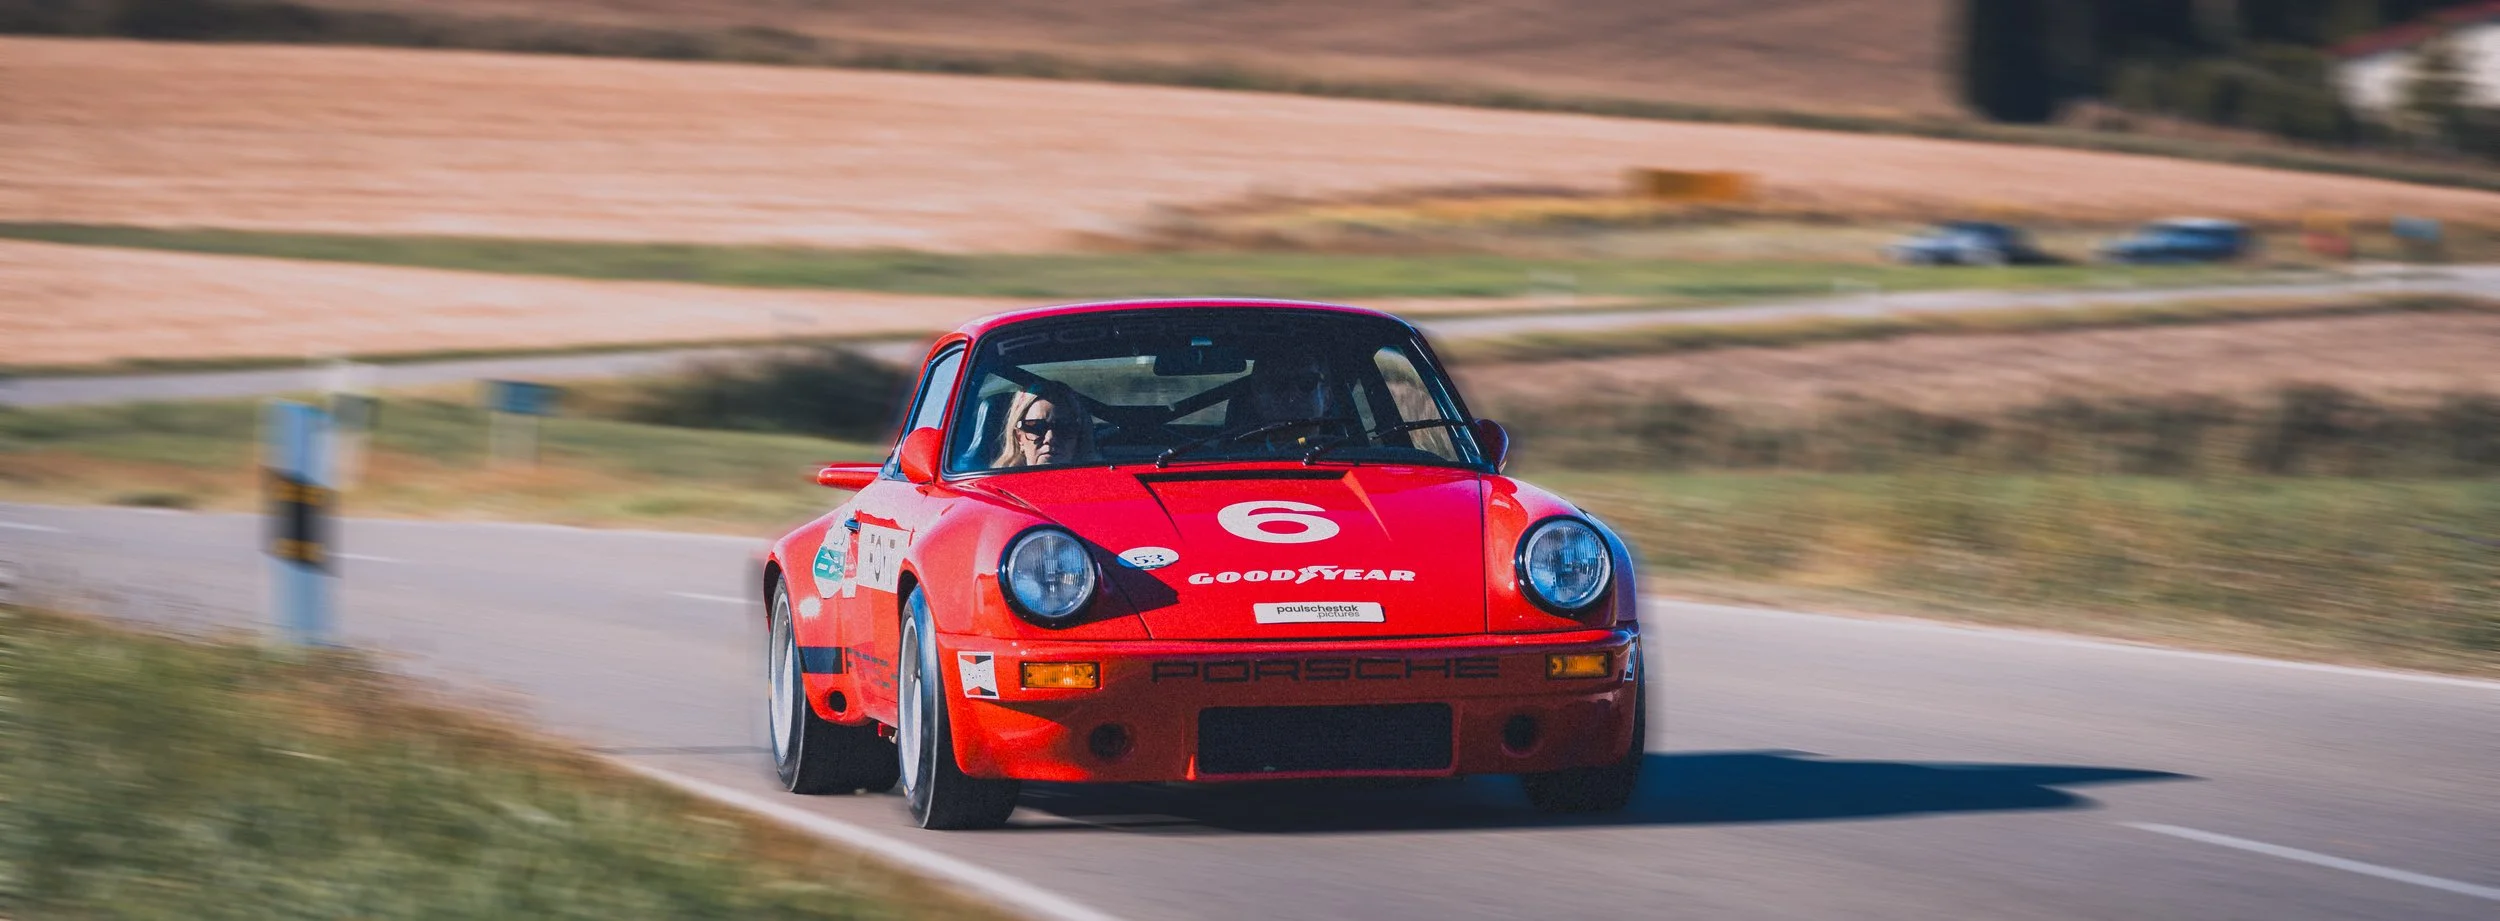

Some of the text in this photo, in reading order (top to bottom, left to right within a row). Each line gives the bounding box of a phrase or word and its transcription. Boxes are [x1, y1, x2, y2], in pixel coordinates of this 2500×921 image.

[1217, 500, 1340, 543] 6
[1188, 566, 1416, 585] GOODYEAR
[1276, 604, 1360, 614] paulschestak
[1152, 656, 1500, 683] PORSCHE
